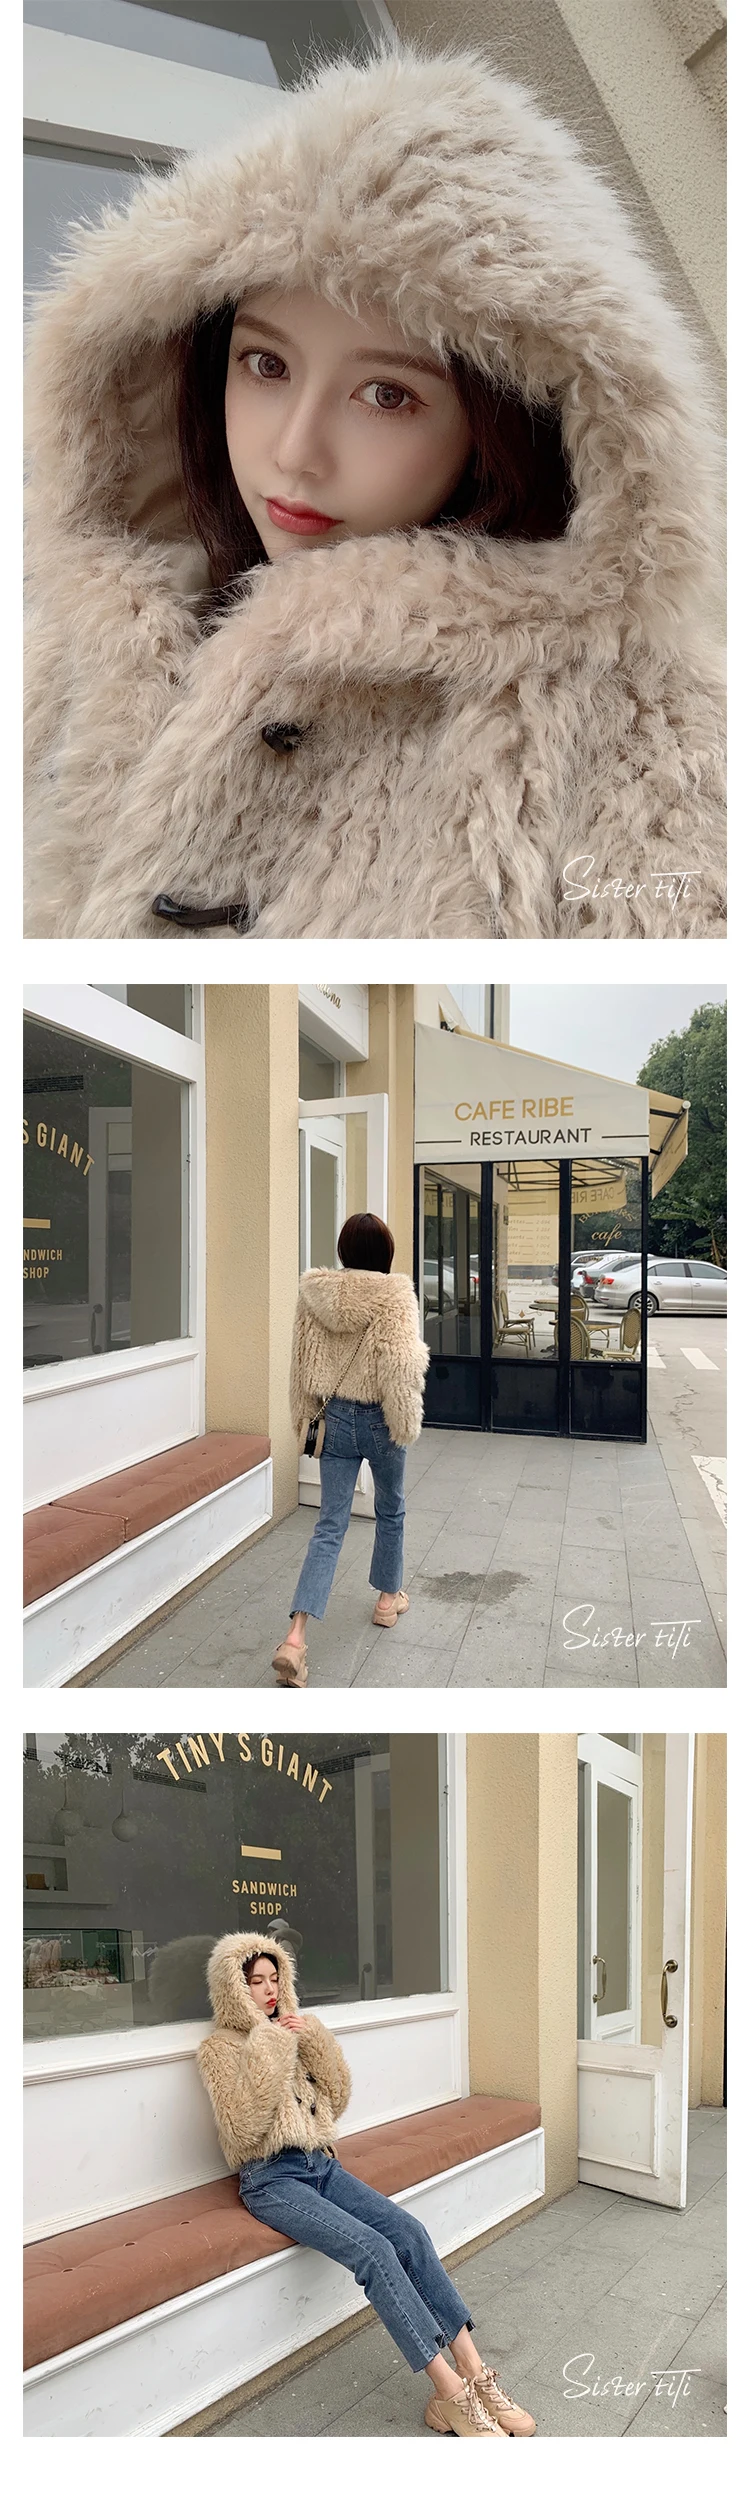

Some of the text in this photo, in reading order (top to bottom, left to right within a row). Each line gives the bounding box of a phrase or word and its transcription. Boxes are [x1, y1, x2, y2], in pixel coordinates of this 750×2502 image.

[455, 1097, 574, 1121] CAFE RIBE
[470, 1128, 592, 1146] RESTAURANT
[37, 1122, 95, 1176] GIANT
[23, 1267, 50, 1279] SHOP
[261, 1738, 333, 1803] GIANT
[232, 1879, 297, 1897] SANDWICH
[250, 1901, 282, 1916] SHOP
